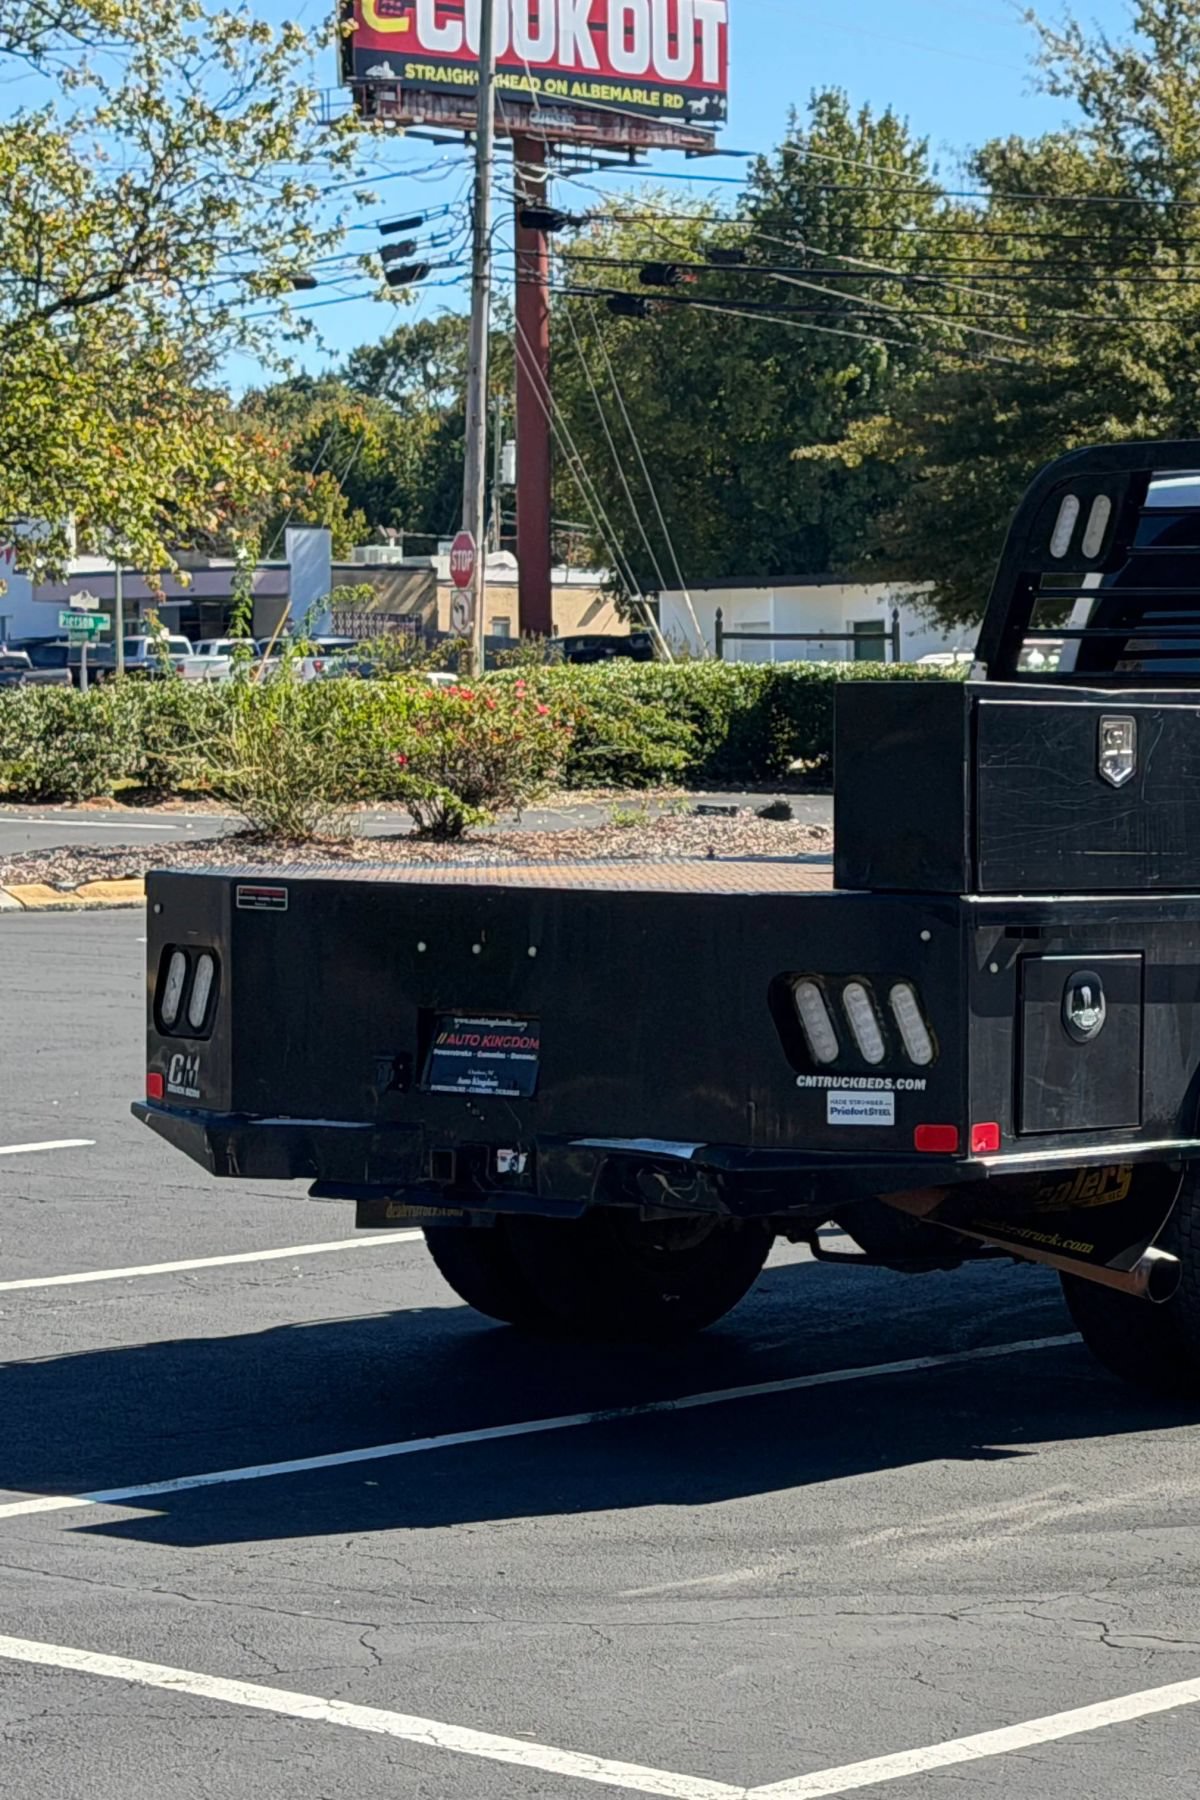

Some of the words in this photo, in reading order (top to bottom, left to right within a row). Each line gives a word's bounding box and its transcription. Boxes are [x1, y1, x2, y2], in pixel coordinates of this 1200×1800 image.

[416, 0, 600, 70] COOK
[608, 0, 728, 84] OUT
[404, 63, 480, 86] STRAIGH
[544, 80, 568, 95] ON
[571, 82, 660, 107] ALBEMARLE
[663, 93, 685, 109] RD
[451, 550, 473, 571] STOP
[447, 1034, 480, 1046] AUTO
[481, 1035, 540, 1049] KINGDOM
[168, 1053, 200, 1088] CM
[796, 1075, 927, 1091] CMTRUCKBEDS.COM
